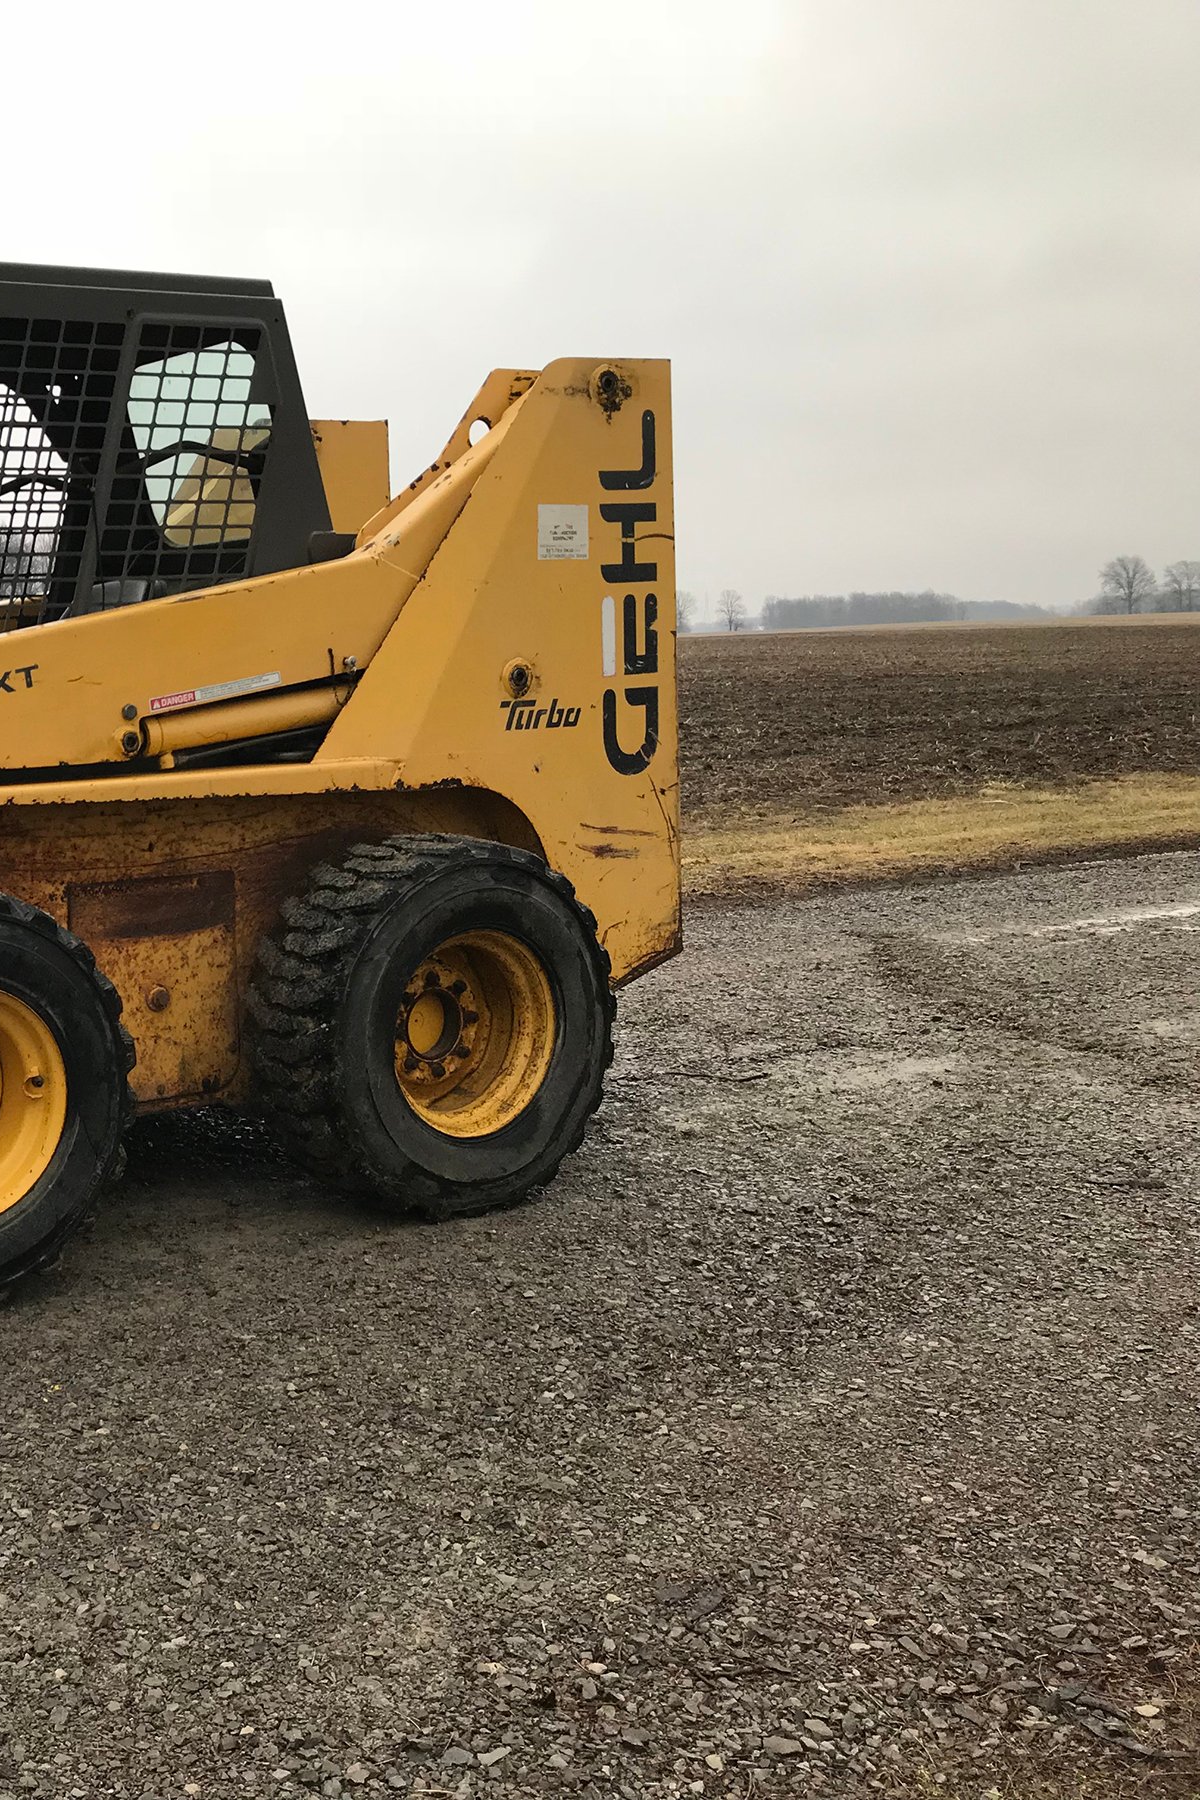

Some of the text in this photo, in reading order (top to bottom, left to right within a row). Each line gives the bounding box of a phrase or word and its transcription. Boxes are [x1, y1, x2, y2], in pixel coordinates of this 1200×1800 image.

[598, 409, 659, 776] GEHL
[160, 692, 195, 707] DANGER
[500, 699, 581, 731] Turbo
